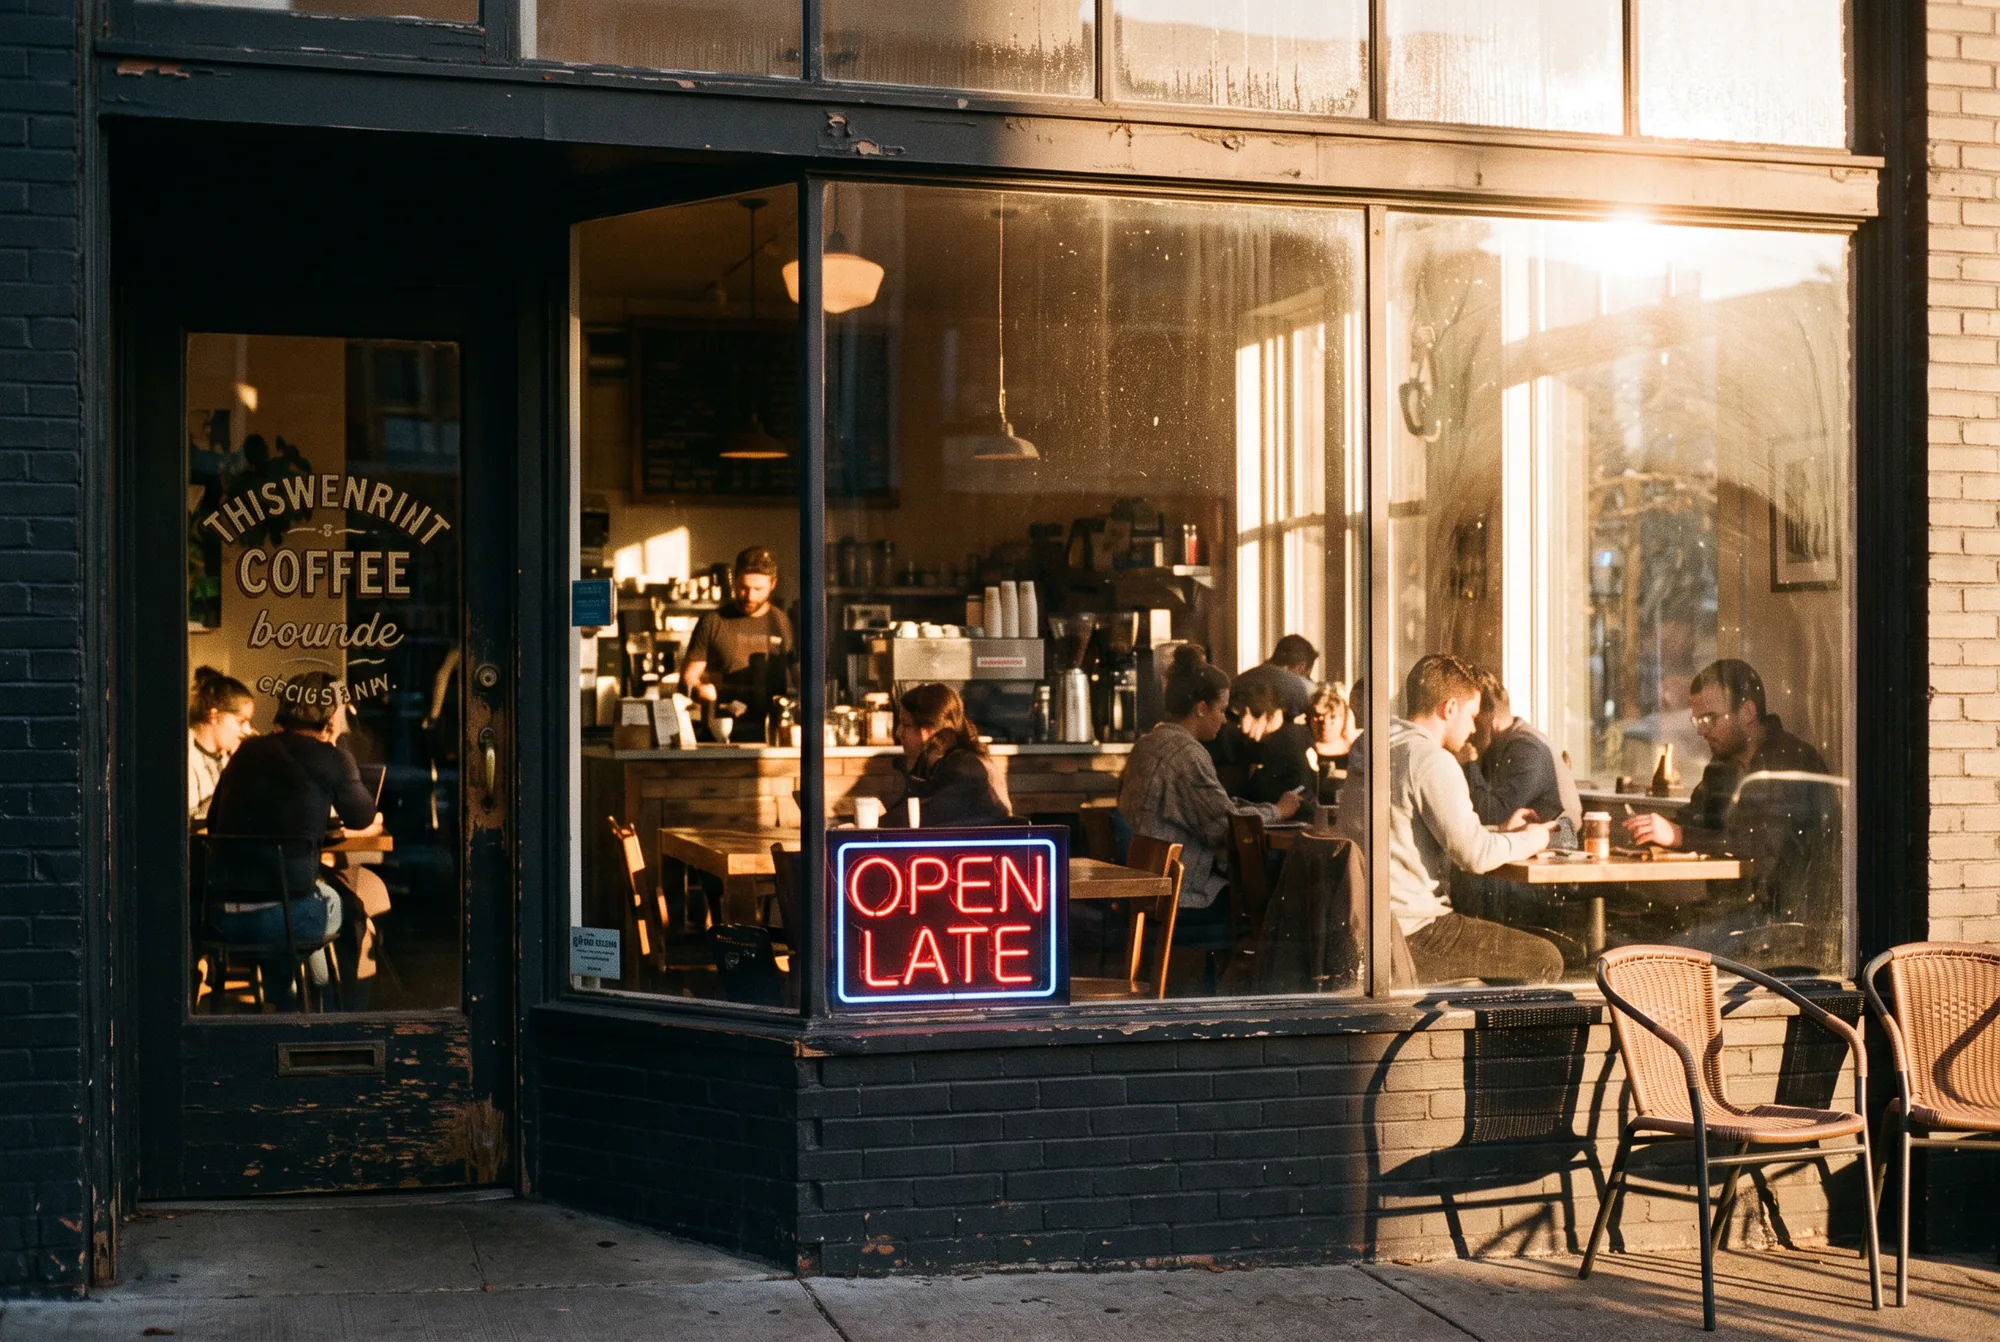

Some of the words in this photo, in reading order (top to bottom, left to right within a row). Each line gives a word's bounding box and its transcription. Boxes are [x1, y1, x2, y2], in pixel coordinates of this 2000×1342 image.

[202, 474, 451, 546] THISWENRINT
[237, 547, 411, 598] COFFEE
[248, 609, 405, 650] bounde
[848, 854, 1045, 917] OPEN
[862, 925, 1034, 987] LATE
